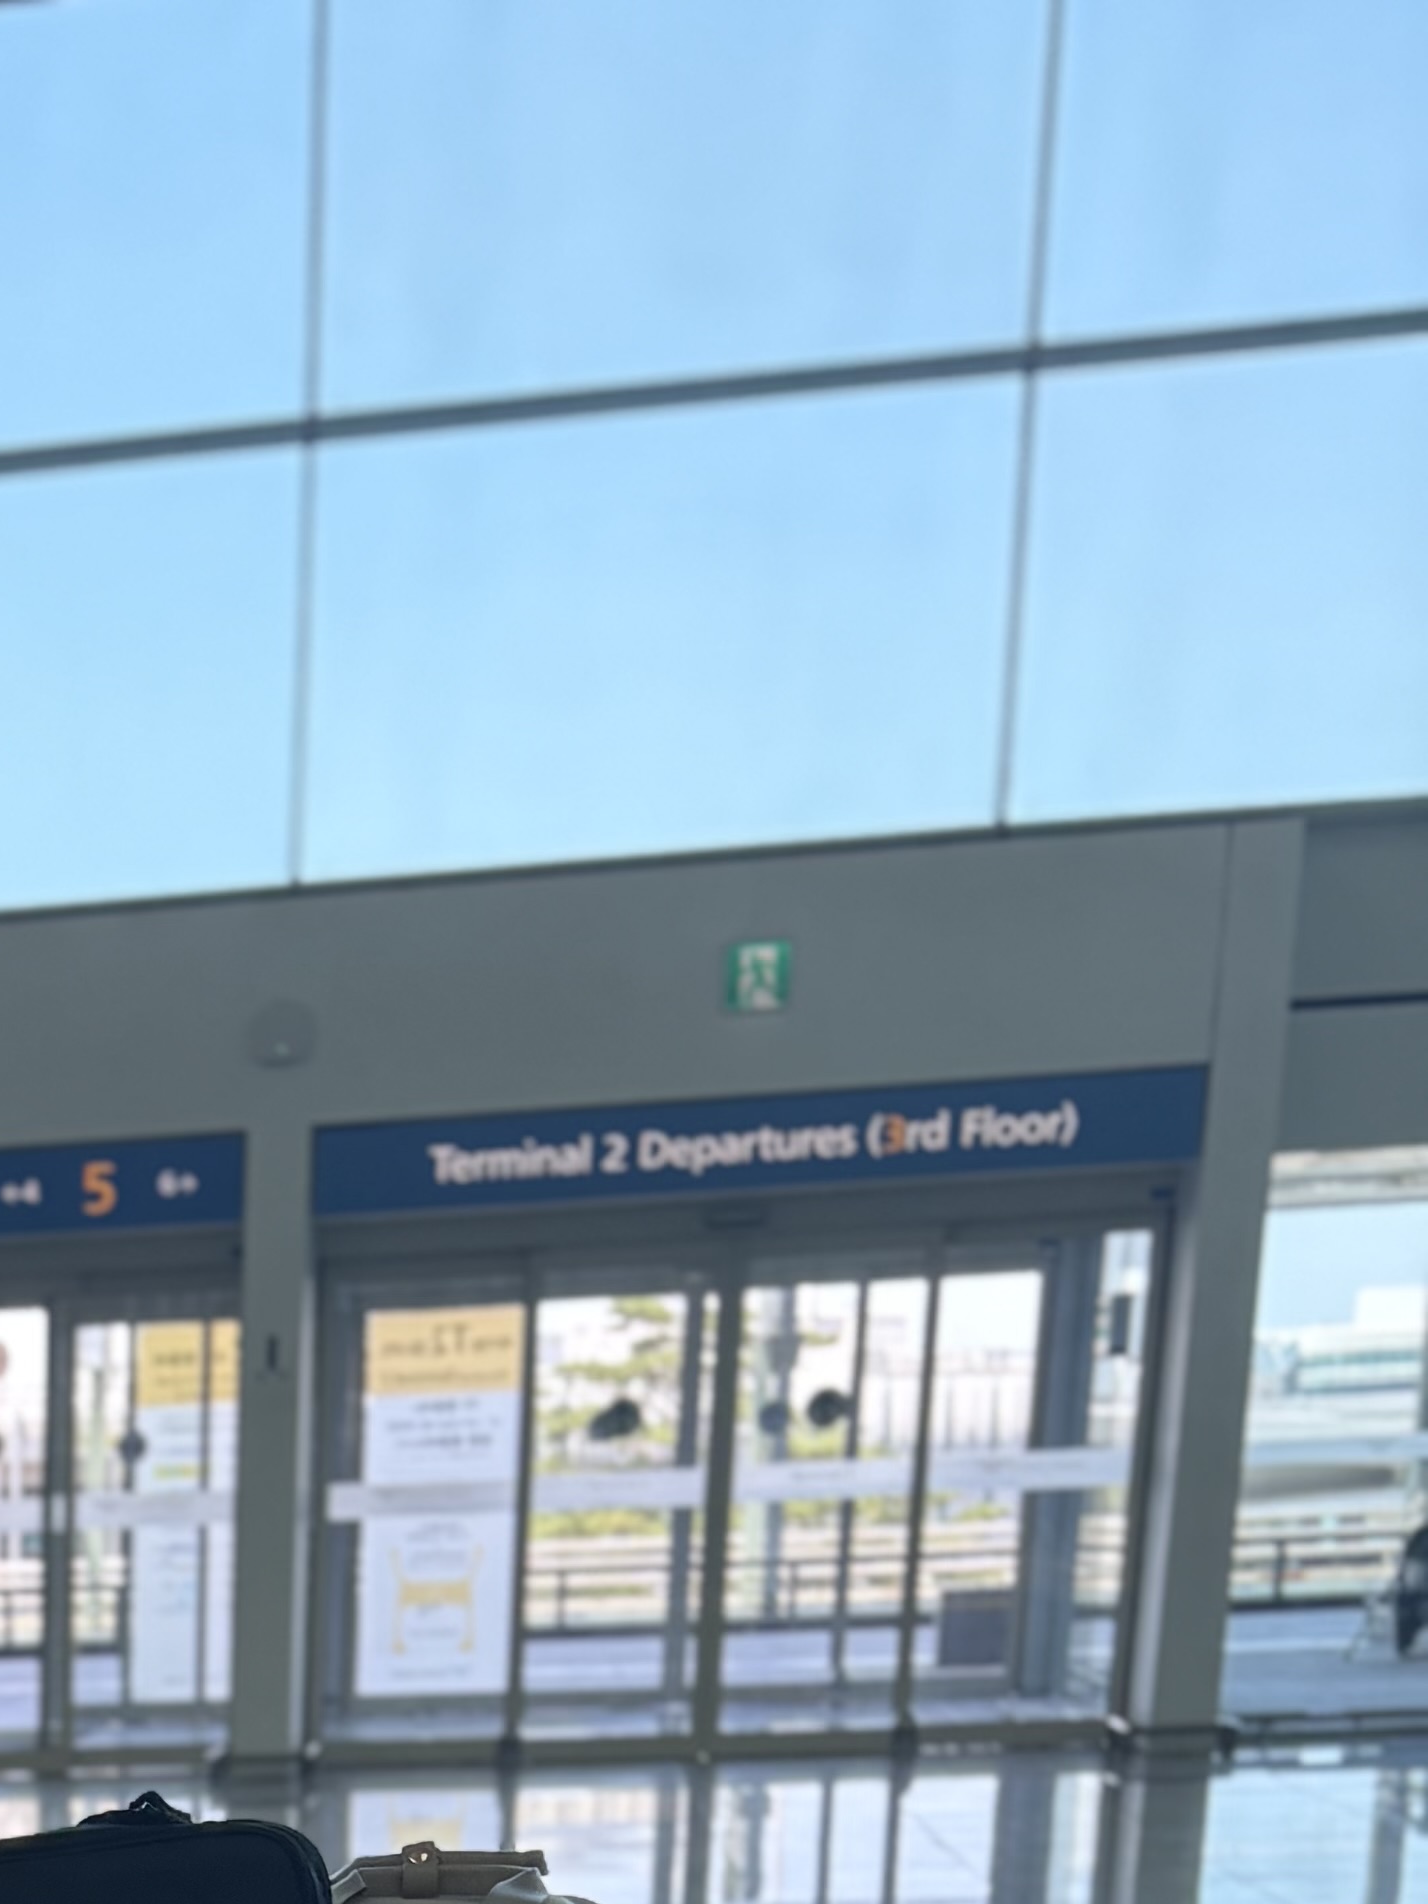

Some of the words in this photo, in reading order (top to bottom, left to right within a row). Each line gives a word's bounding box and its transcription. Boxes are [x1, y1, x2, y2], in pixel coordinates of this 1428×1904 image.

[428, 1133, 593, 1186] Terminal
[600, 1132, 629, 1174] 2
[636, 1121, 857, 1176] Departures
[867, 1111, 950, 1160] (3rd
[960, 1099, 1080, 1151] Floor)
[80, 1158, 119, 1217] 5
